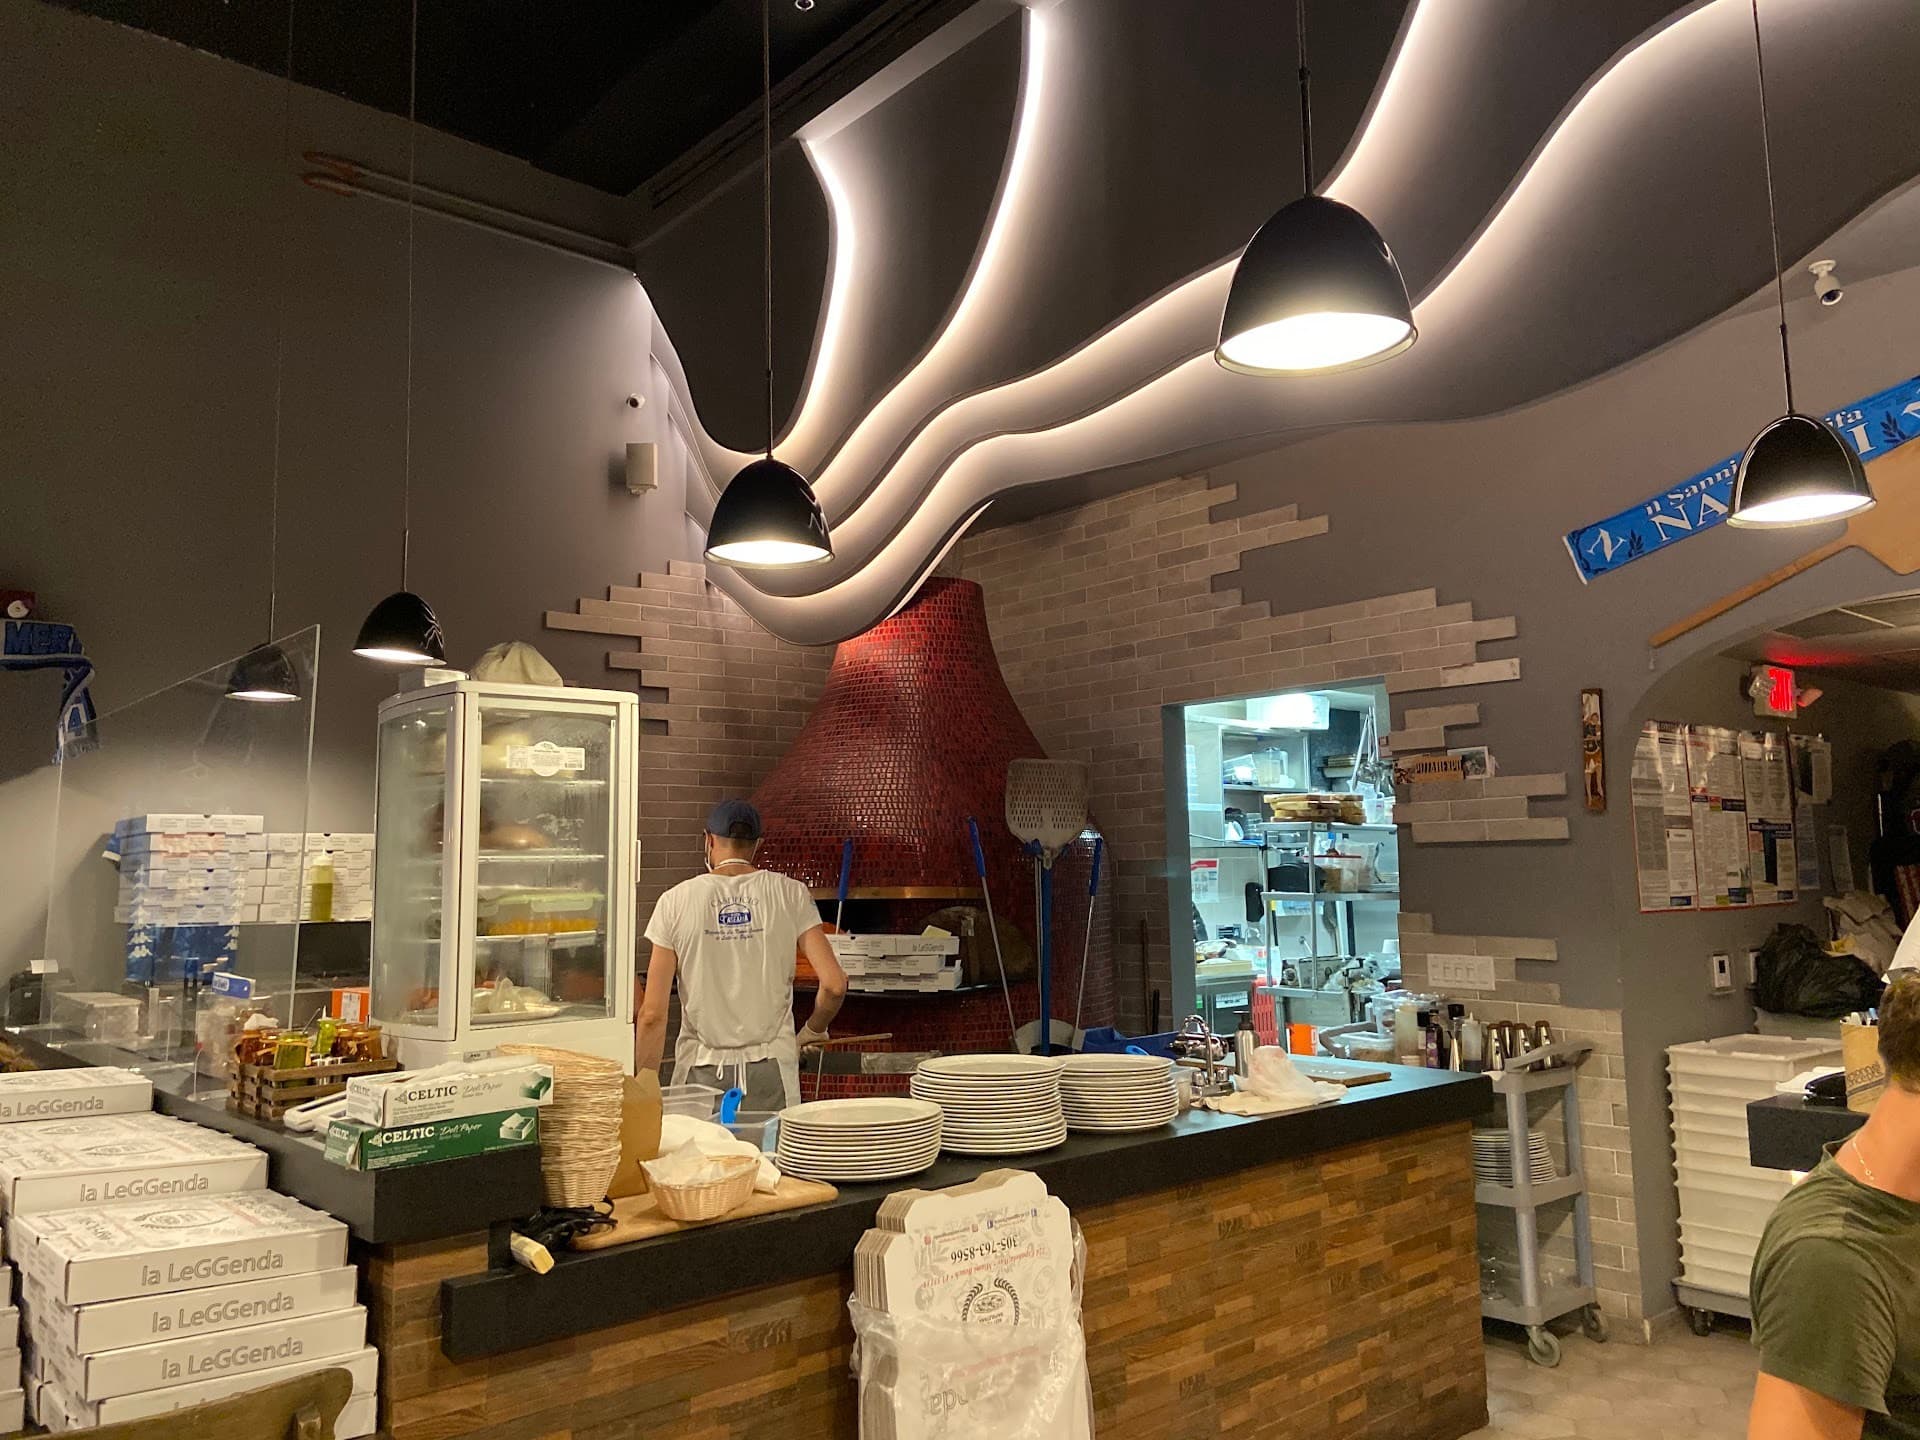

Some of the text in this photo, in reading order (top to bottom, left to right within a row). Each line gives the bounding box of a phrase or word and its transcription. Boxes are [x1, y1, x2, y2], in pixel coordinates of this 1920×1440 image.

[1645, 410, 1864, 515] il Sanni ifa
[17, 1096, 104, 1116] LeGGenda
[408, 1085, 458, 1102] CELTIC
[382, 1126, 435, 1144] CELTIC
[440, 1125, 460, 1136] Deli
[460, 1123, 483, 1135] Paper
[80, 1174, 209, 1201] la LeGGenda
[950, 1235, 1018, 1264] 305-763-8566
[142, 1249, 284, 1286] la LeGGenda
[152, 1292, 295, 1333] la LeGGenda
[162, 1336, 304, 1380] la LeGGenda
